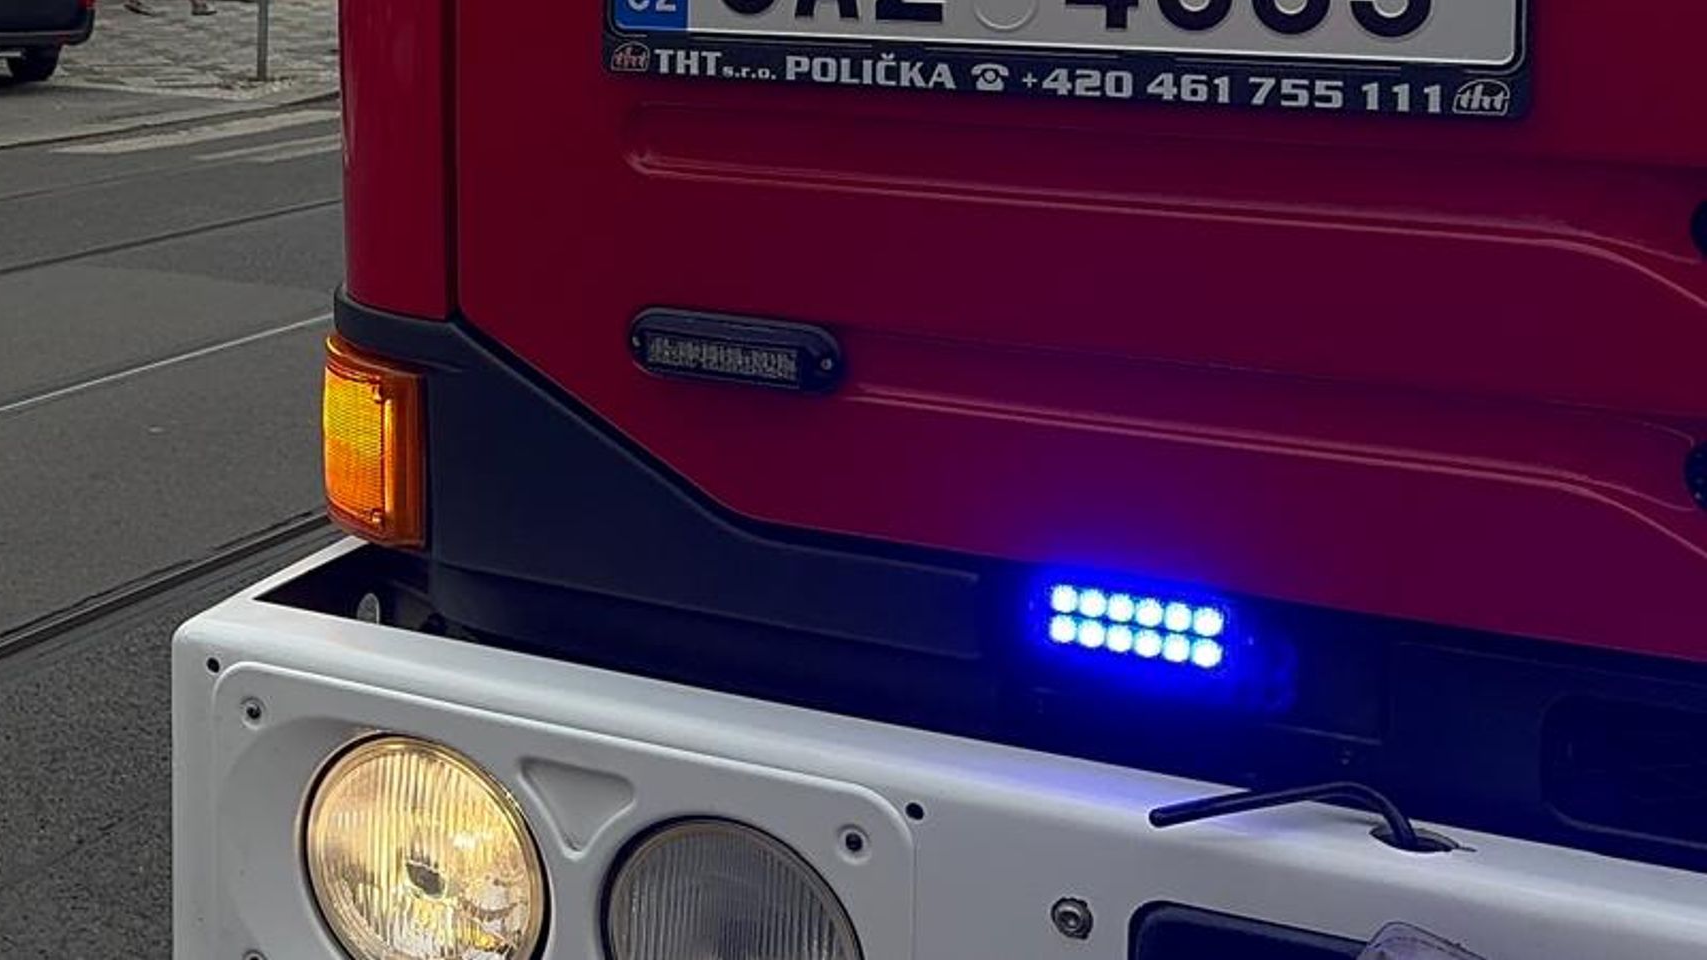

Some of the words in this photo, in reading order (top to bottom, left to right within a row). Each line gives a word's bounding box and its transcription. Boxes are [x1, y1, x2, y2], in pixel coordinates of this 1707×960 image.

[654, 48, 723, 78] THT
[722, 64, 777, 81] s.r.o.
[785, 53, 956, 90] POLIČKA
[1022, 68, 1134, 100] +420
[1146, 72, 1232, 104] 461
[1248, 76, 1344, 109] 755
[1360, 82, 1442, 113] 111
